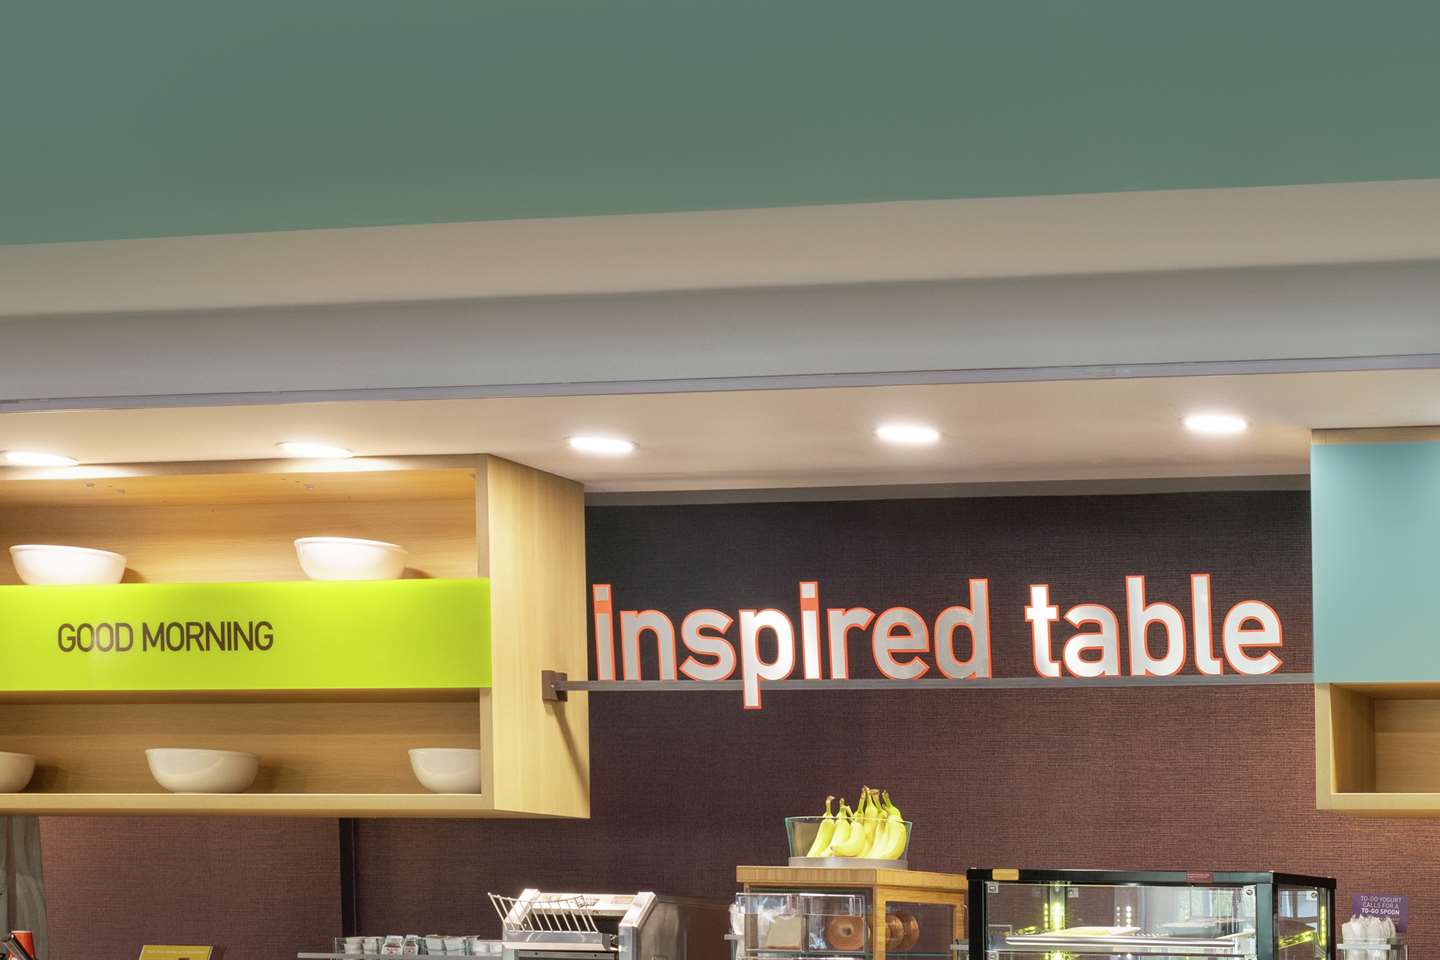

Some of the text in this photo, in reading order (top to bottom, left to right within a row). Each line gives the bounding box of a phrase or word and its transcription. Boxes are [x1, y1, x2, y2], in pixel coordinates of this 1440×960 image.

[57, 620, 274, 652] GOOD MORNING
[592, 573, 1283, 709] inspired table
